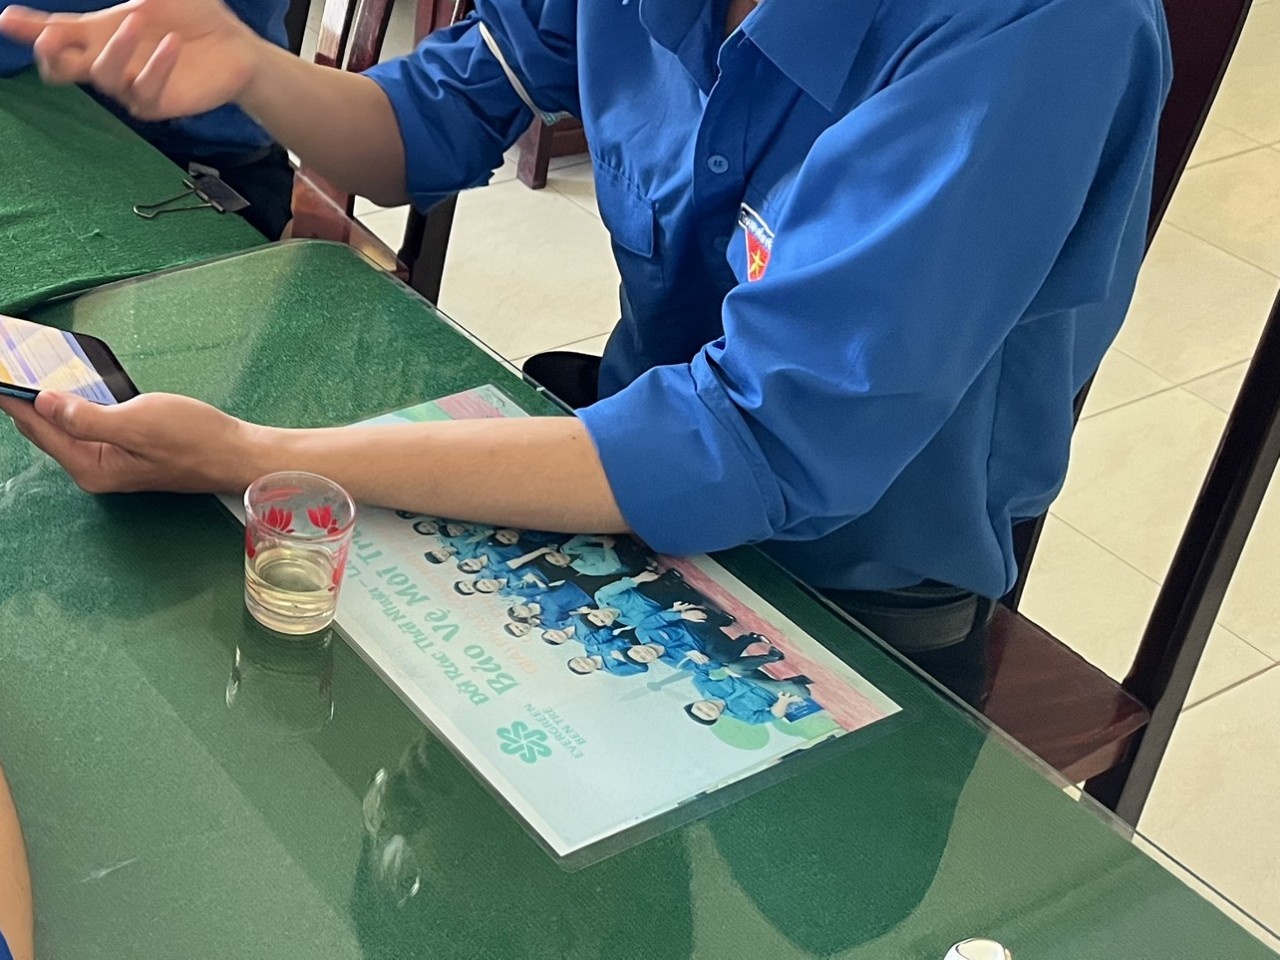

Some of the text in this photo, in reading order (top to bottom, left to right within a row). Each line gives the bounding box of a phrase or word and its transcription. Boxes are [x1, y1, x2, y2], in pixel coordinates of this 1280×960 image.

[376, 566, 431, 606] Môi
[424, 608, 460, 642] Vệ
[432, 651, 464, 681] Rác
[464, 645, 520, 695] Bảo
[523, 703, 584, 759] EVERGREEN
